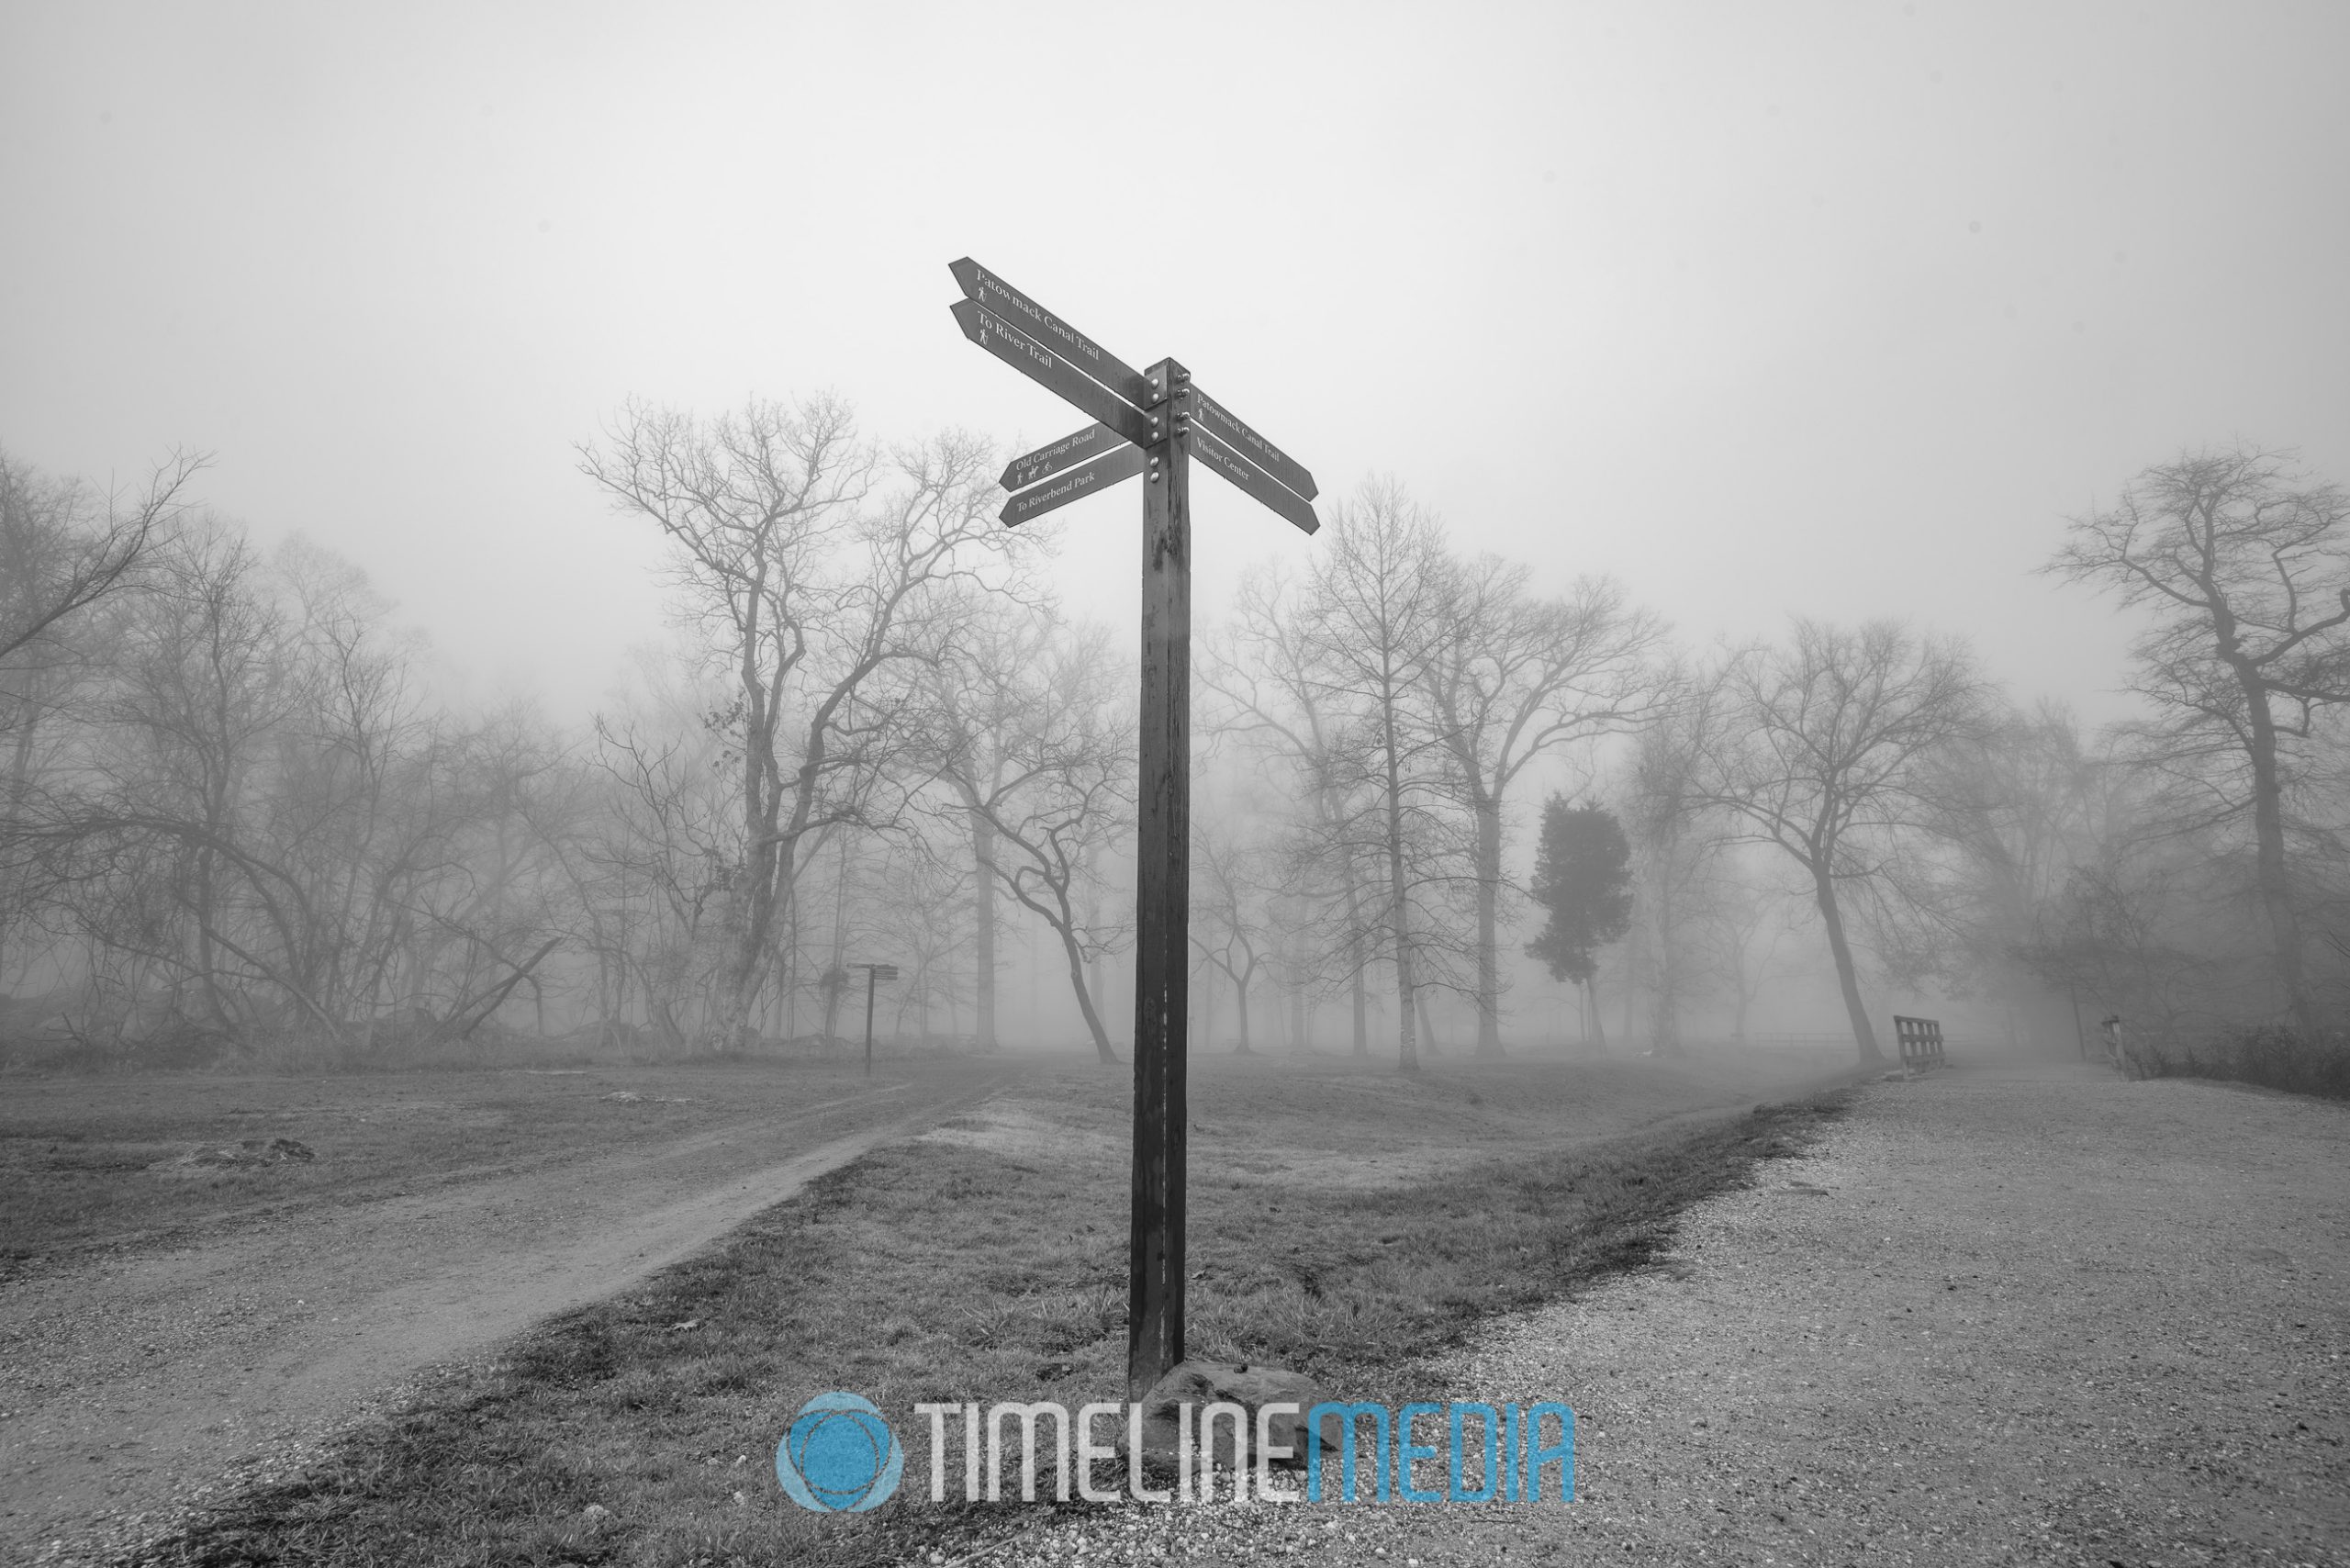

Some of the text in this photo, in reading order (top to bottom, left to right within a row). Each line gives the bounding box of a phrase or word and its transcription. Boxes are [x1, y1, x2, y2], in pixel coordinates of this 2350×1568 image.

[978, 310, 1052, 368] To River Trail
[1044, 316, 1074, 343] Canal
[1076, 336, 1099, 361] Trail
[1197, 393, 1280, 462] Patowmack Canal Trail
[1016, 429, 1095, 471] Old Carriage Road
[1197, 437, 1249, 480] Visitor Center
[1017, 471, 1095, 512] To Riverbend Park
